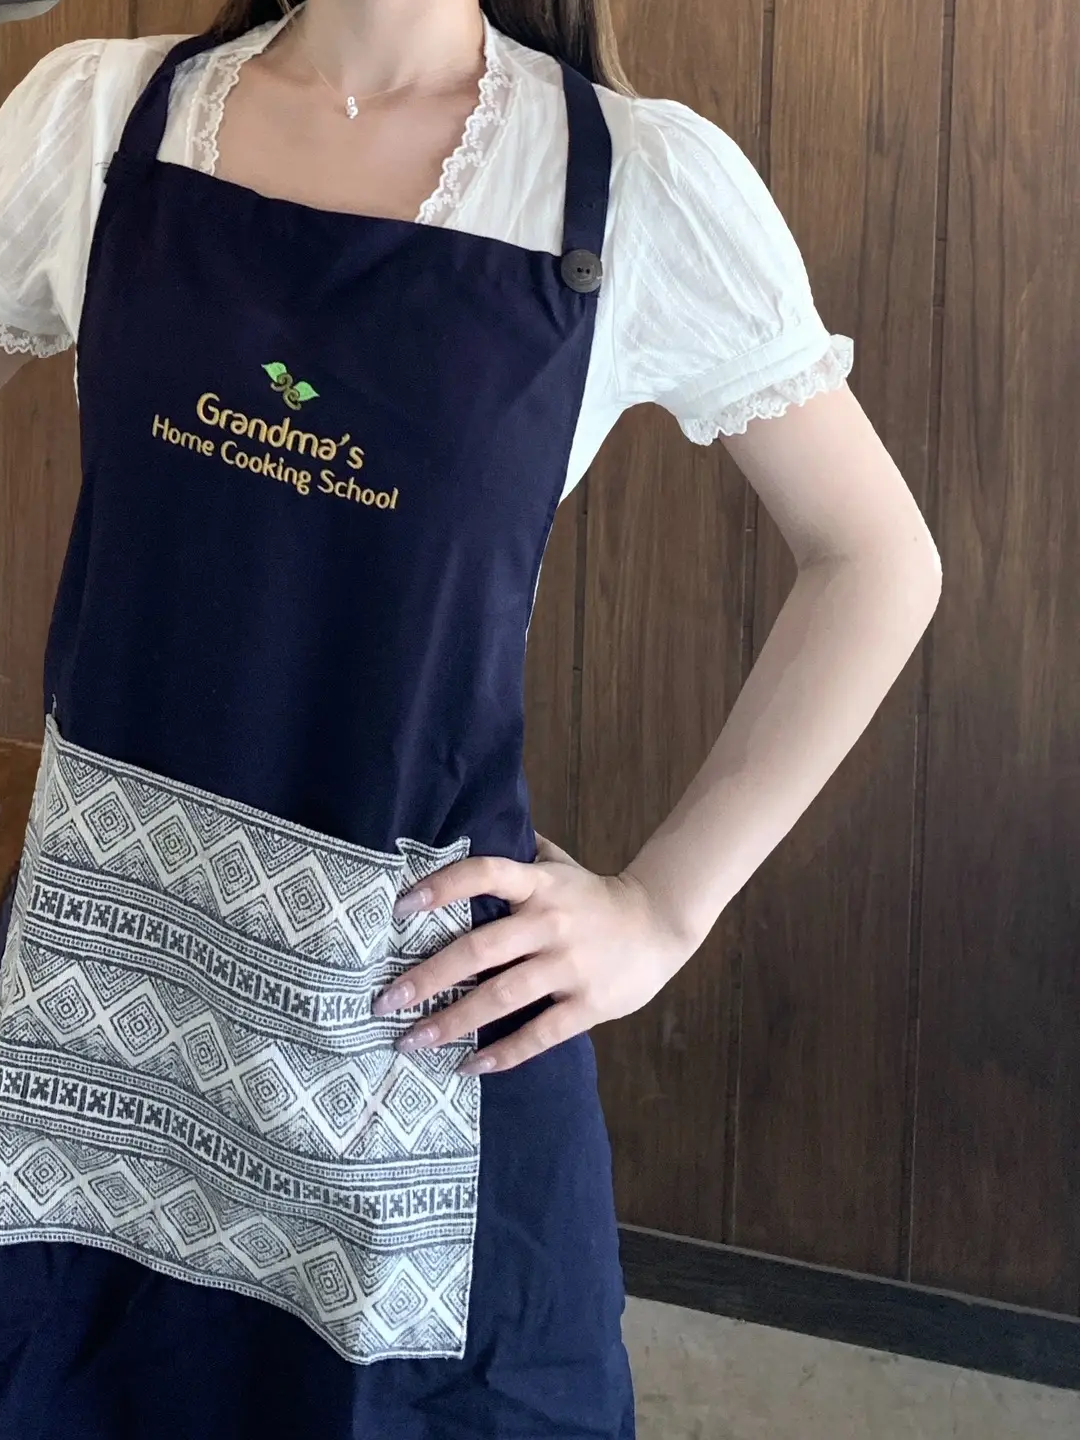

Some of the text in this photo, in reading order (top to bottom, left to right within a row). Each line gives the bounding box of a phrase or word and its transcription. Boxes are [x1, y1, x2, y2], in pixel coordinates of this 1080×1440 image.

[152, 414, 398, 509] Home Cooking School
[196, 393, 364, 469] Grandma's
